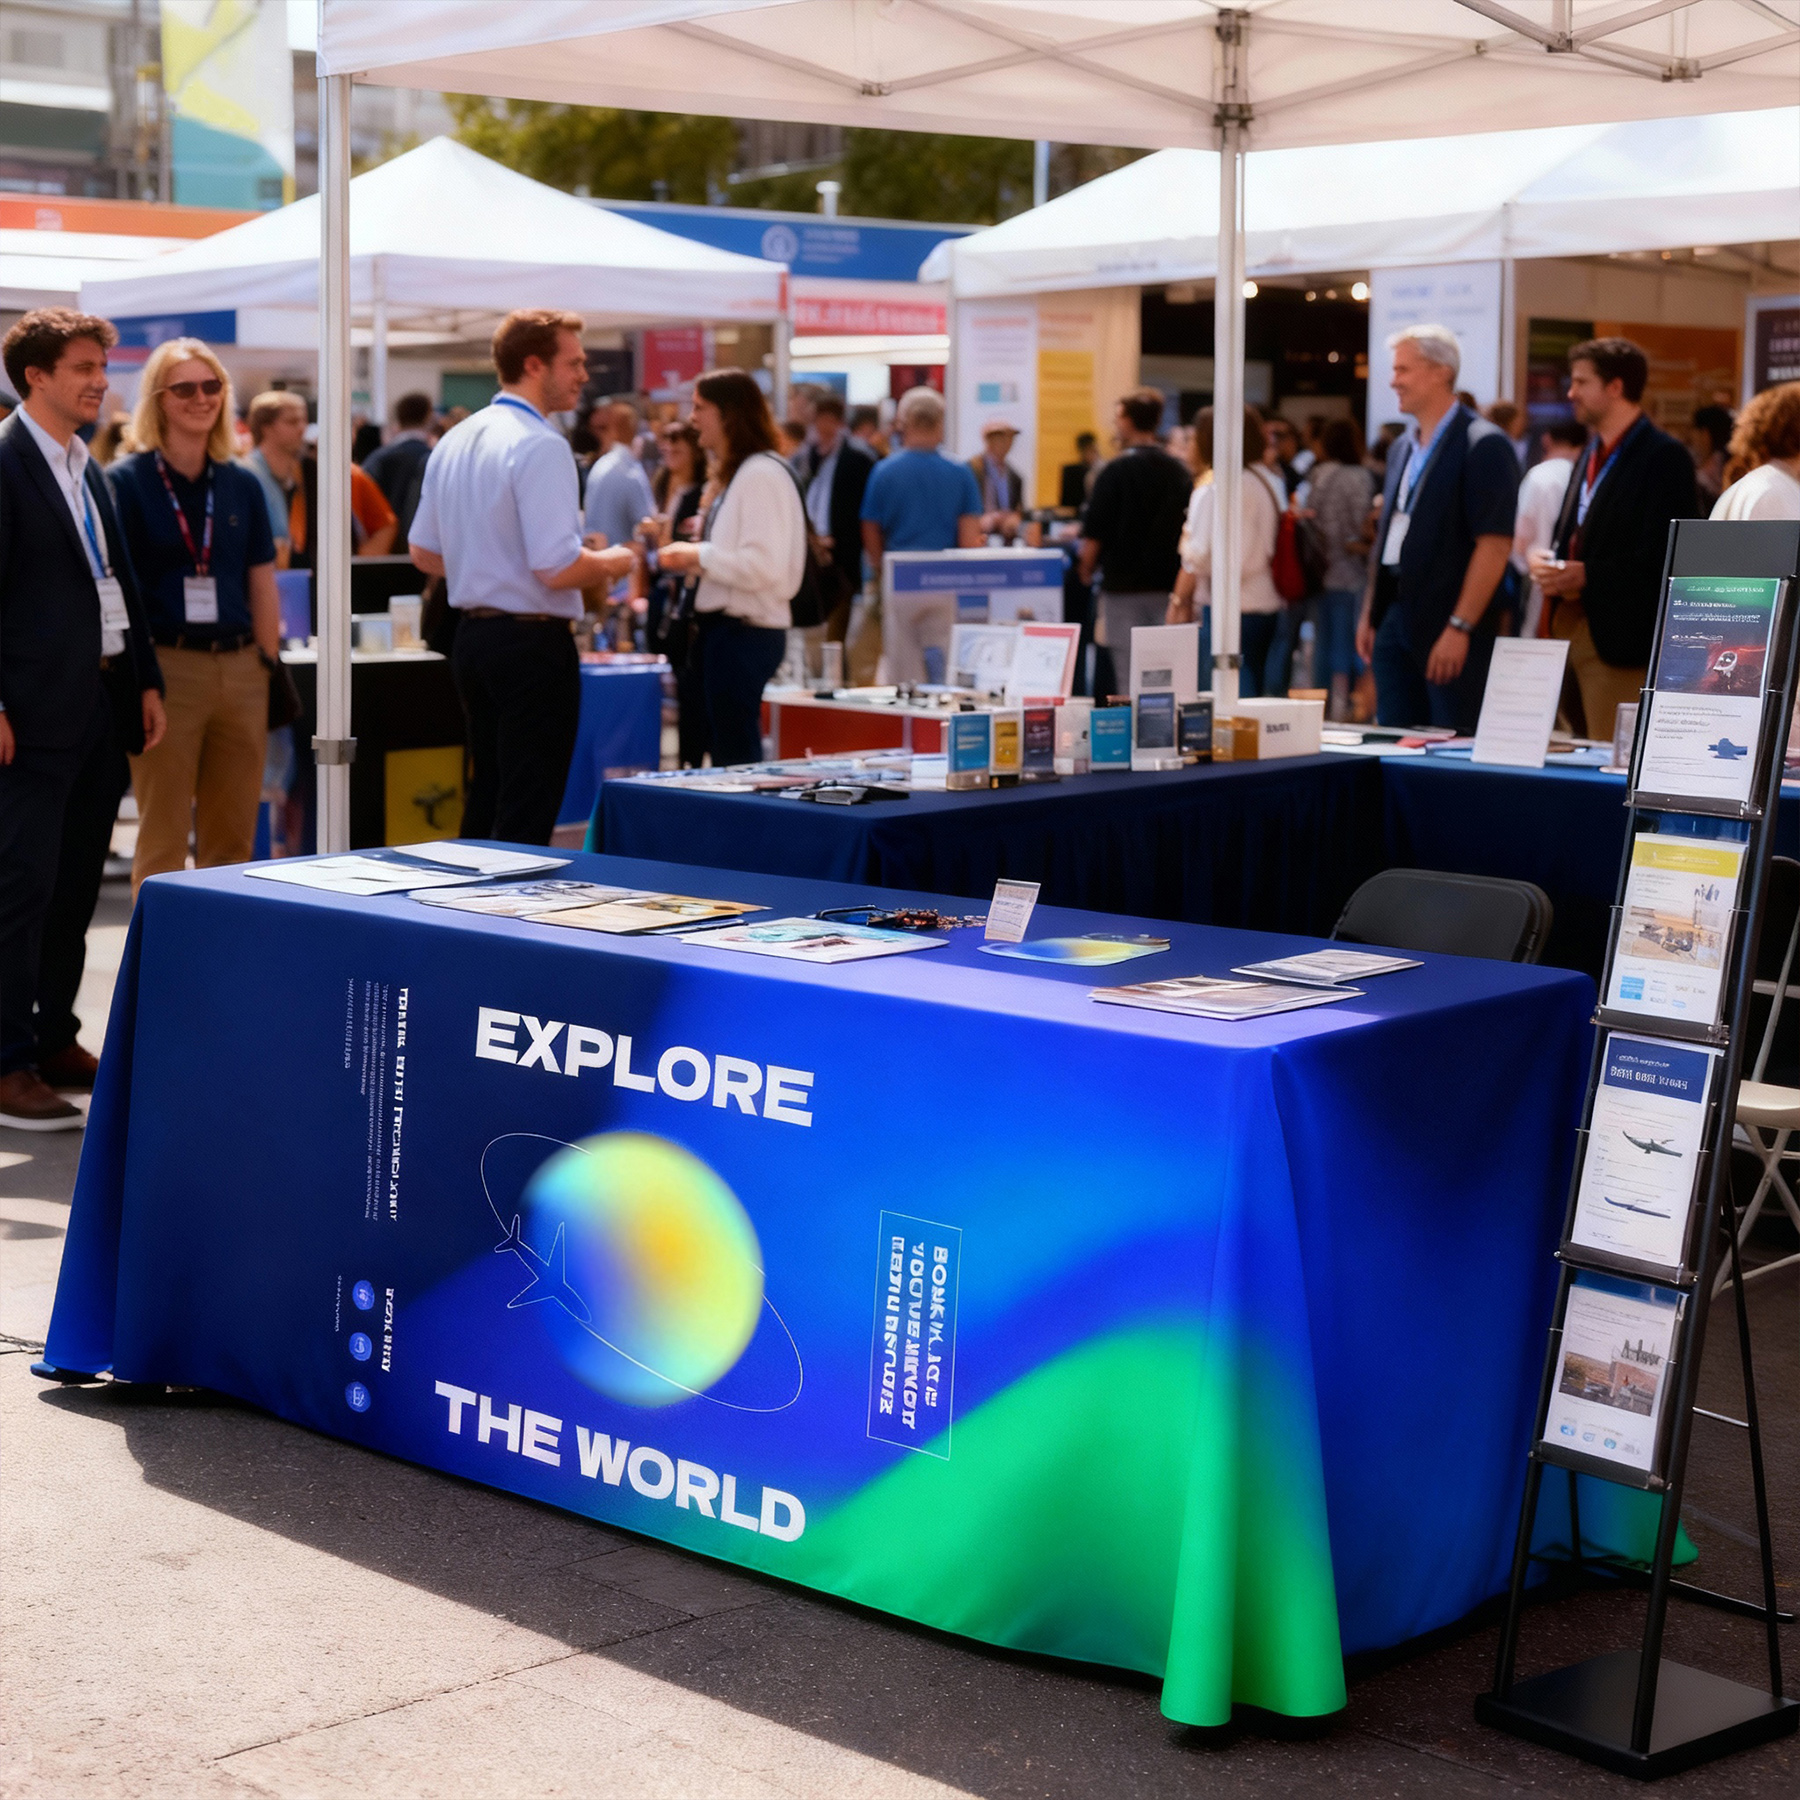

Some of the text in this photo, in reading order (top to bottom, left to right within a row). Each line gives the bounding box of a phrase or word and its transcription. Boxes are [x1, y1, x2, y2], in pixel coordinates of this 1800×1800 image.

[475, 1006, 815, 1127] EXPLORE
[435, 1380, 806, 1542] THE WORLD
